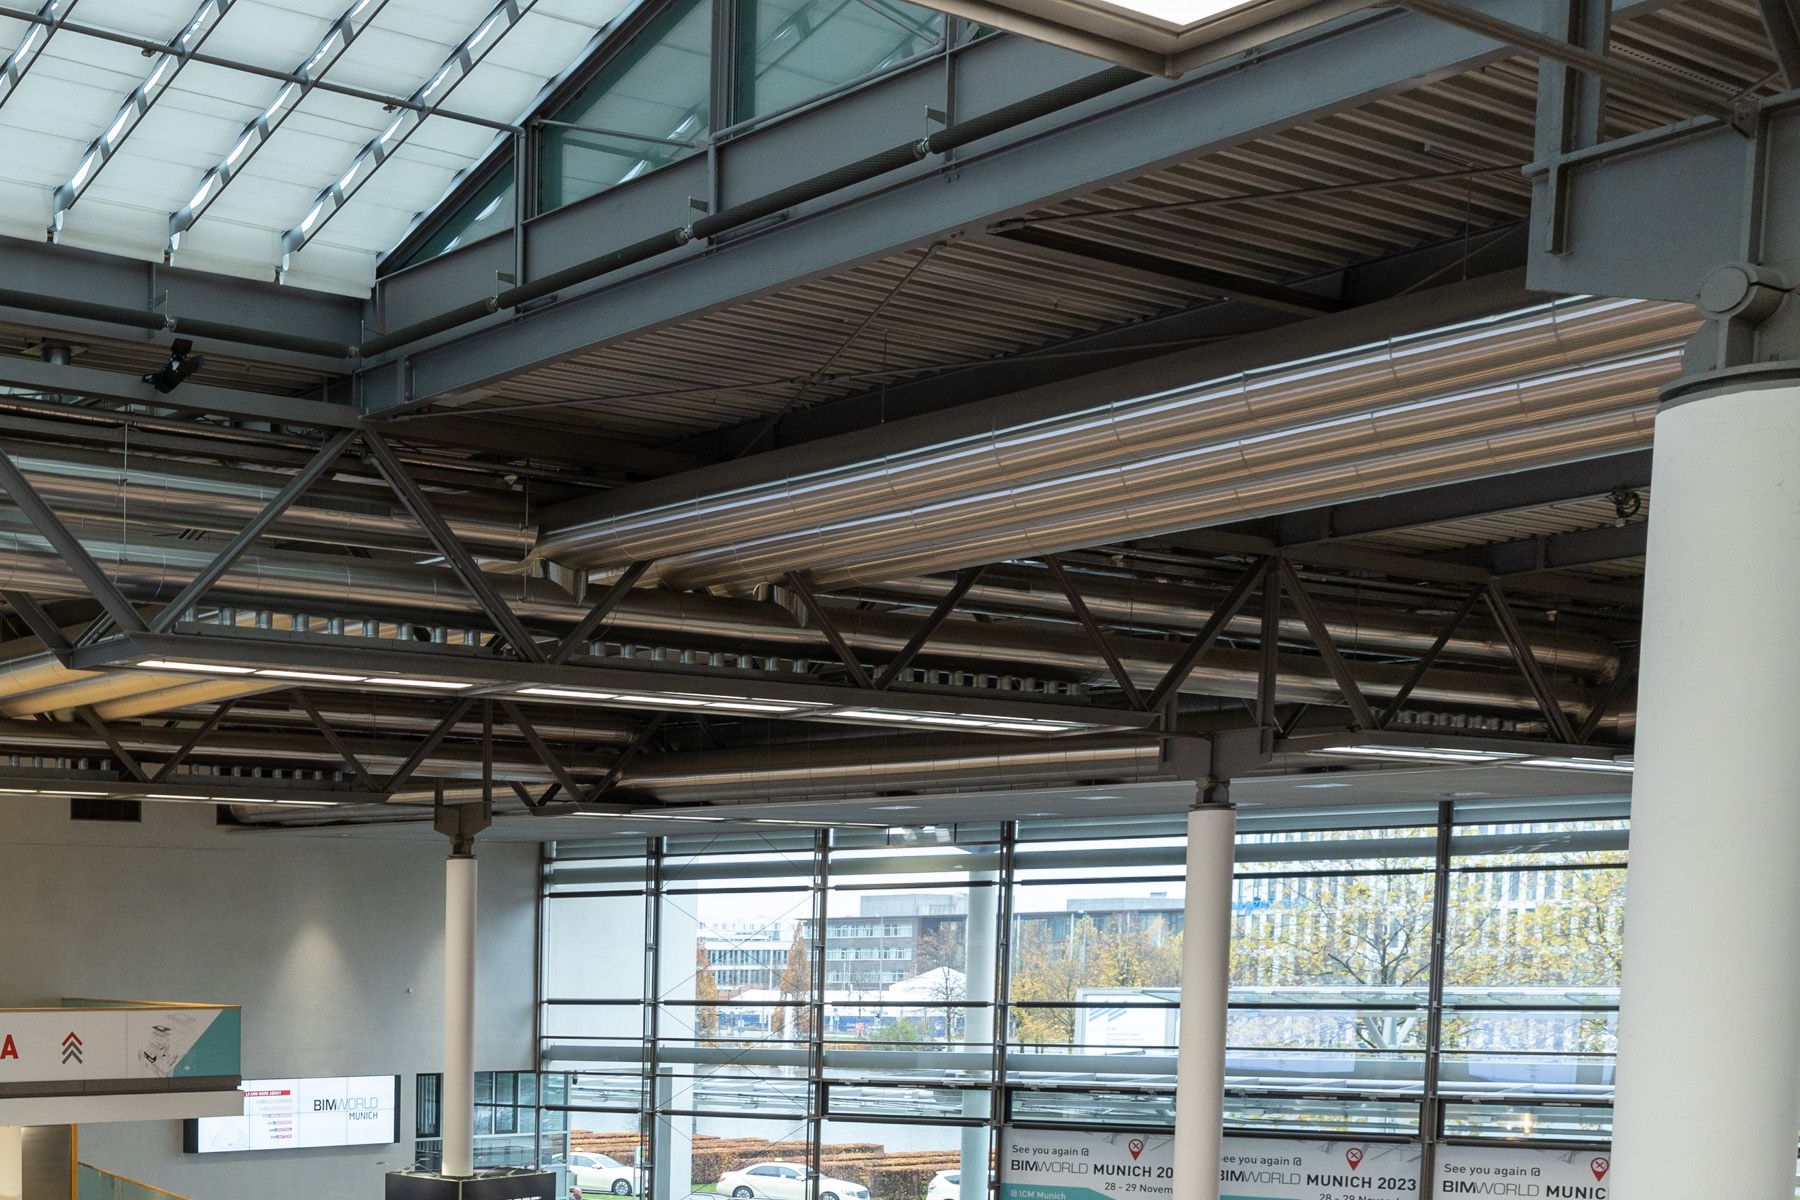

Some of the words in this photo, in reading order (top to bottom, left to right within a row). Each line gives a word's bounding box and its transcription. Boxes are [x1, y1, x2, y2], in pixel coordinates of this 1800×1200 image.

[314, 1096, 378, 1112] BIMWORLD
[348, 1111, 378, 1120] MUNICH
[1012, 1144, 1030, 1154] See
[1032, 1146, 1049, 1156] you
[1052, 1147, 1078, 1157] again
[1238, 1156, 1257, 1166] you
[1260, 1156, 1290, 1167] again
[1011, 1160, 1088, 1174] BIMWORLD
[1093, 1164, 1152, 1178] MUNICH
[1156, 1166, 1174, 1179] 20
[1444, 1163, 1466, 1174] See
[1469, 1166, 1490, 1176] you
[1494, 1167, 1527, 1178] again
[1104, 1182, 1116, 1191] 28
[1125, 1183, 1137, 1192] 29
[1140, 1184, 1173, 1194] Novem
[1306, 1174, 1372, 1189] MUNICH
[1377, 1178, 1417, 1192] 2023
[1442, 1180, 1540, 1197] BIMWORLD
[1546, 1184, 1610, 1200] MUNIC
[1019, 1190, 1035, 1198] ICM
[1036, 1192, 1066, 1200] Munich
